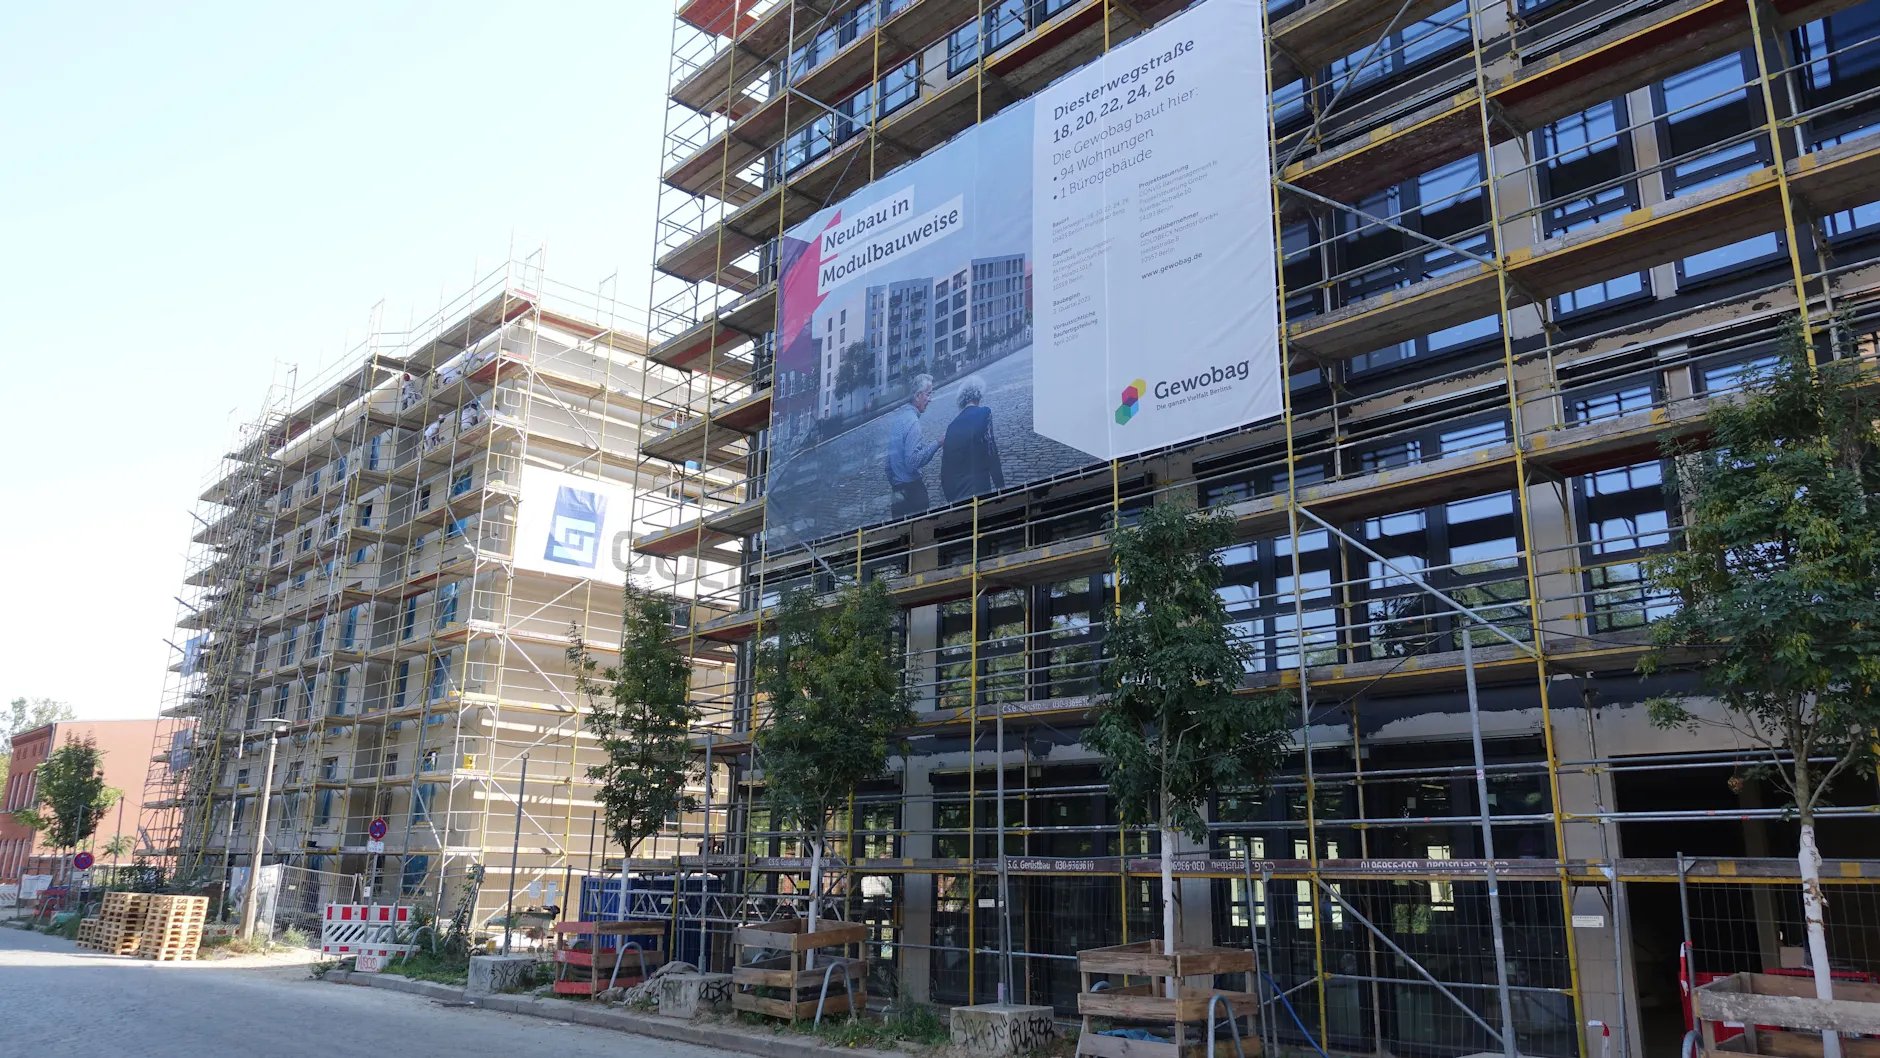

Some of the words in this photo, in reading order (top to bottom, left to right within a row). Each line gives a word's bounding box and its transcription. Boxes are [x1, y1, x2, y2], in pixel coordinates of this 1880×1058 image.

[1054, 38, 1194, 120] Diesterwegstraße
[1053, 124, 1073, 143] 18,
[1076, 111, 1097, 131] 20,
[1100, 97, 1123, 117] 22,
[1127, 84, 1151, 104] 24,
[1154, 69, 1175, 91] 26
[1053, 148, 1072, 165] Die
[1074, 118, 1132, 154] Gewobag
[1135, 102, 1165, 124] baut
[1168, 87, 1199, 108] hier:
[1060, 164, 1074, 181] 94
[1076, 127, 1153, 171] Wohnungen
[1061, 187, 1066, 199] 1
[1069, 147, 1152, 194] Bürogebäude
[1138, 164, 1188, 188] Projektsteuerung
[822, 208, 958, 287] Modulbauweise
[824, 209, 887, 253] Neubau
[892, 198, 909, 218] in
[1140, 211, 1198, 238] Generalübernehmer
[1141, 252, 1202, 279] www.gewobag.de
[1158, 246, 1175, 257] Berlin
[1154, 360, 1249, 400] Gewobag
[1167, 398, 1185, 407] ganze
[1187, 390, 1208, 401] Vielfalt
